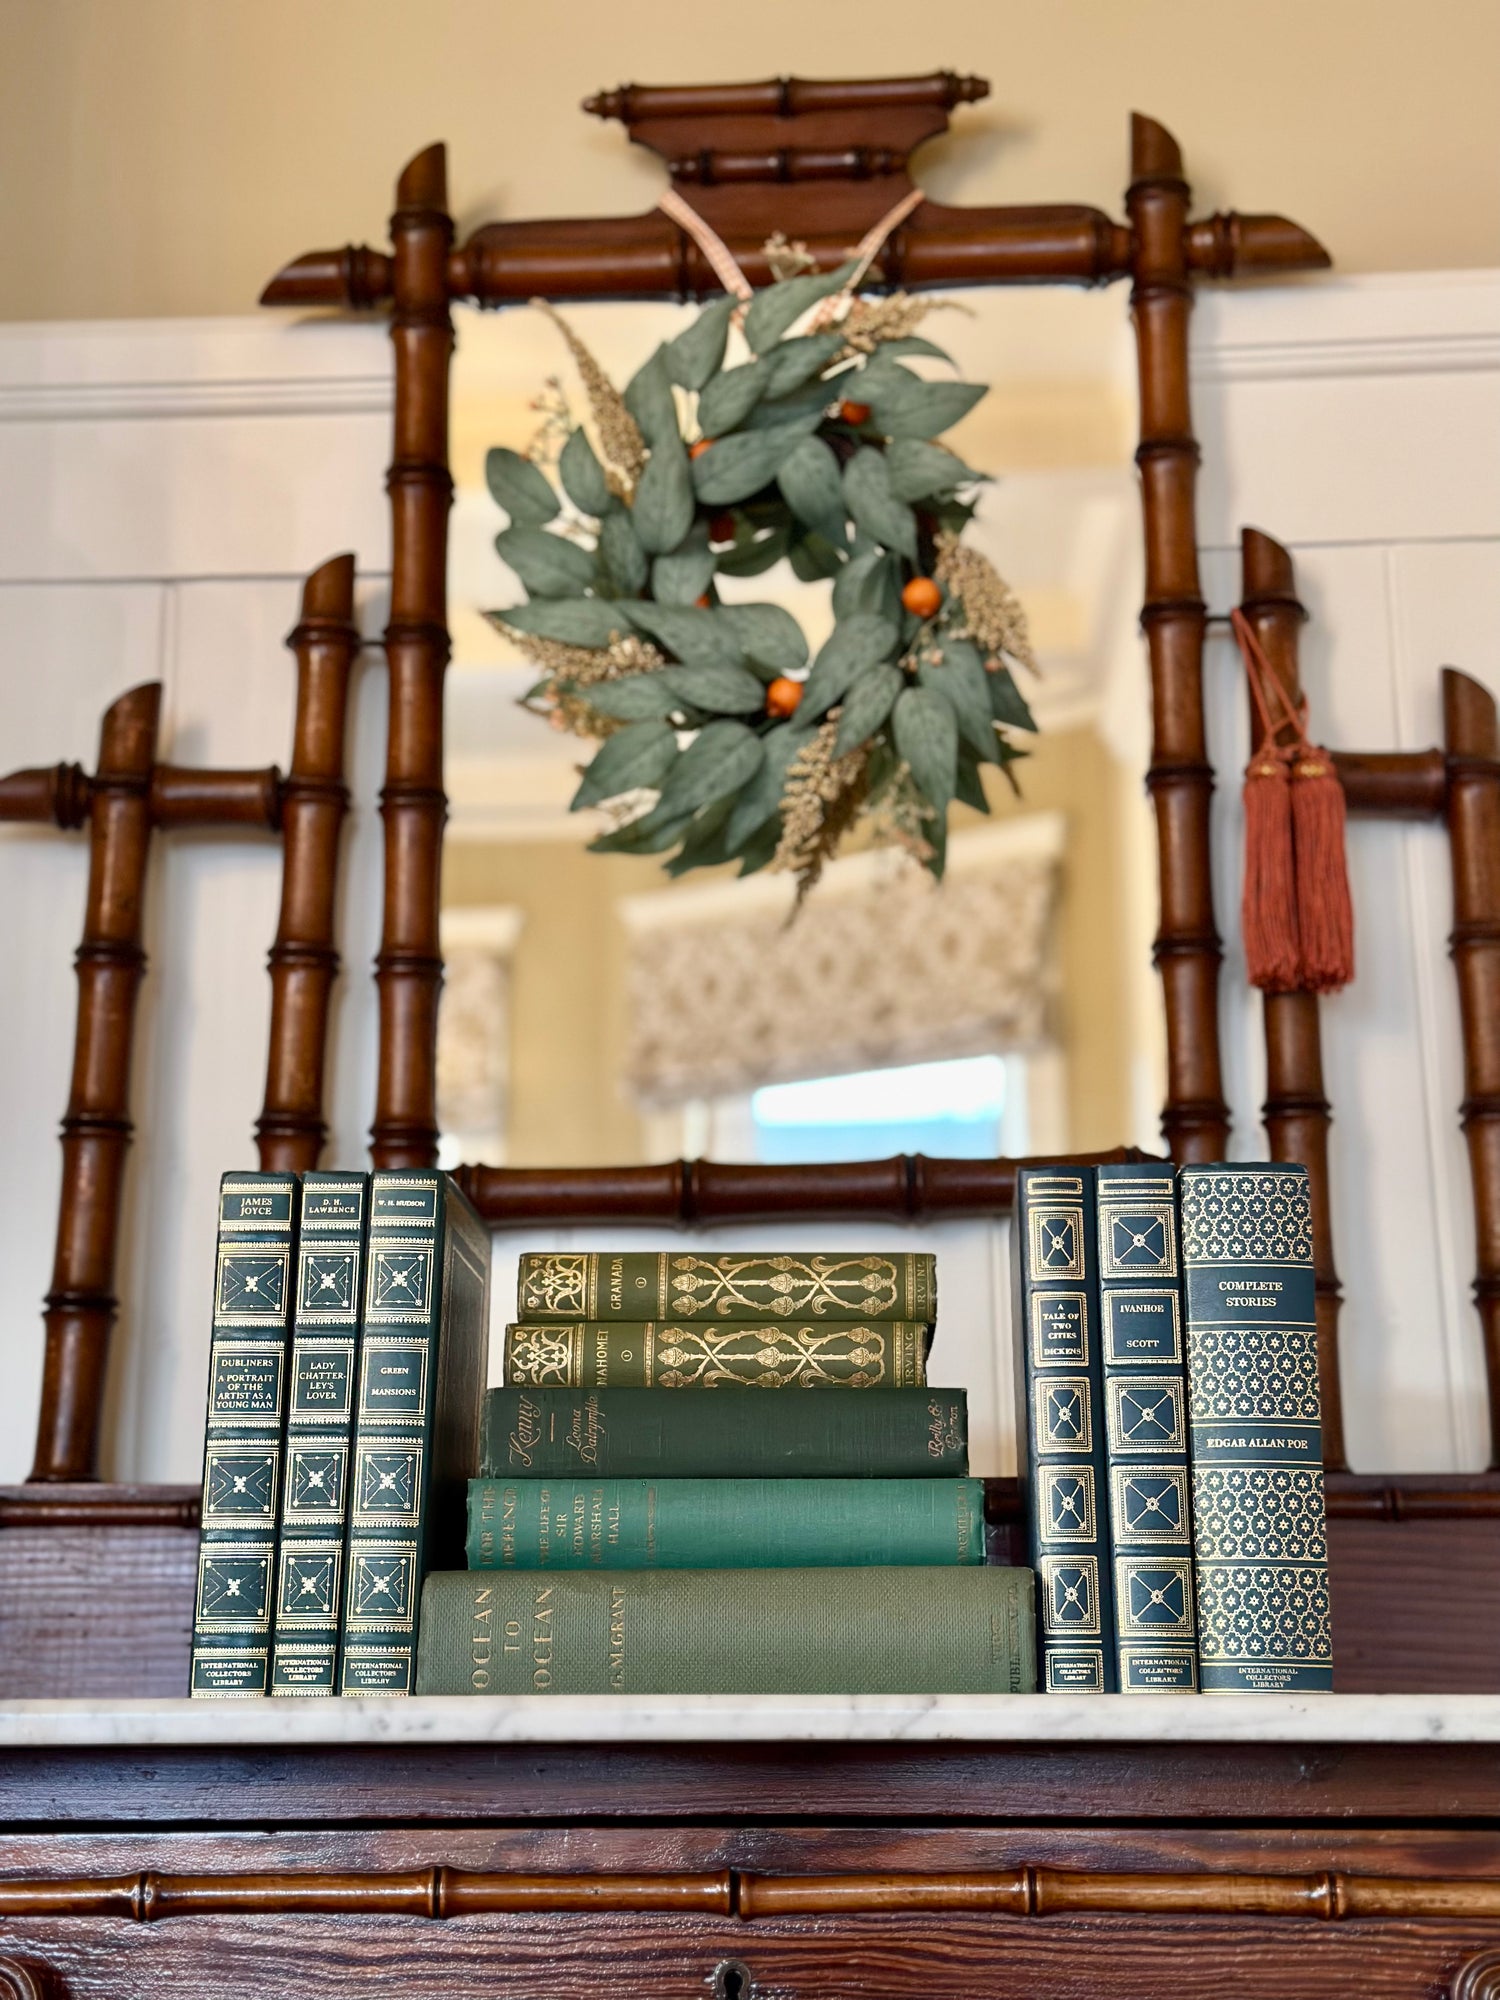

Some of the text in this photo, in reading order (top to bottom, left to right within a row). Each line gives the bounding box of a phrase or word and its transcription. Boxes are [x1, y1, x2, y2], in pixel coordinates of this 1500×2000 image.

[240, 1198, 273, 1206] JAMES
[240, 1207, 272, 1216] JOYCE
[396, 1199, 425, 1207] HUDSON
[610, 1258, 623, 1310] GRANADA
[916, 1260, 925, 1310] IRVING
[1218, 1281, 1283, 1291] COMPLETE
[1120, 1304, 1164, 1312] IVANHOE
[1226, 1298, 1277, 1307] STORIES
[1126, 1340, 1159, 1348] SCOTT
[221, 1359, 274, 1367] DUBLINERS
[310, 1362, 335, 1370] LADY
[596, 1330, 608, 1386] MAHOMET
[904, 1332, 914, 1384] IRVING
[299, 1372, 347, 1380] CHATTER-
[310, 1382, 334, 1390] LEY'S
[306, 1392, 337, 1400] LOVER
[371, 1388, 416, 1396] MANSIONS
[216, 1401, 273, 1409] YOUNG MAN
[509, 1395, 541, 1467] Kenny
[566, 1409, 581, 1451] Leona
[580, 1395, 605, 1465] Dalrymple
[1206, 1438, 1308, 1448] EDGAR ALLAN POE
[480, 1485, 495, 1565] FOR THE
[540, 1505, 550, 1535] LIFE
[556, 1513, 567, 1538] SIR
[573, 1494, 585, 1556] EDWARD
[591, 1488, 604, 1563] MARSHALL
[608, 1504, 620, 1544] HALL
[471, 1588, 493, 1688] OCEAN
[504, 1620, 521, 1652] TO
[533, 1588, 554, 1689] OCEAN
